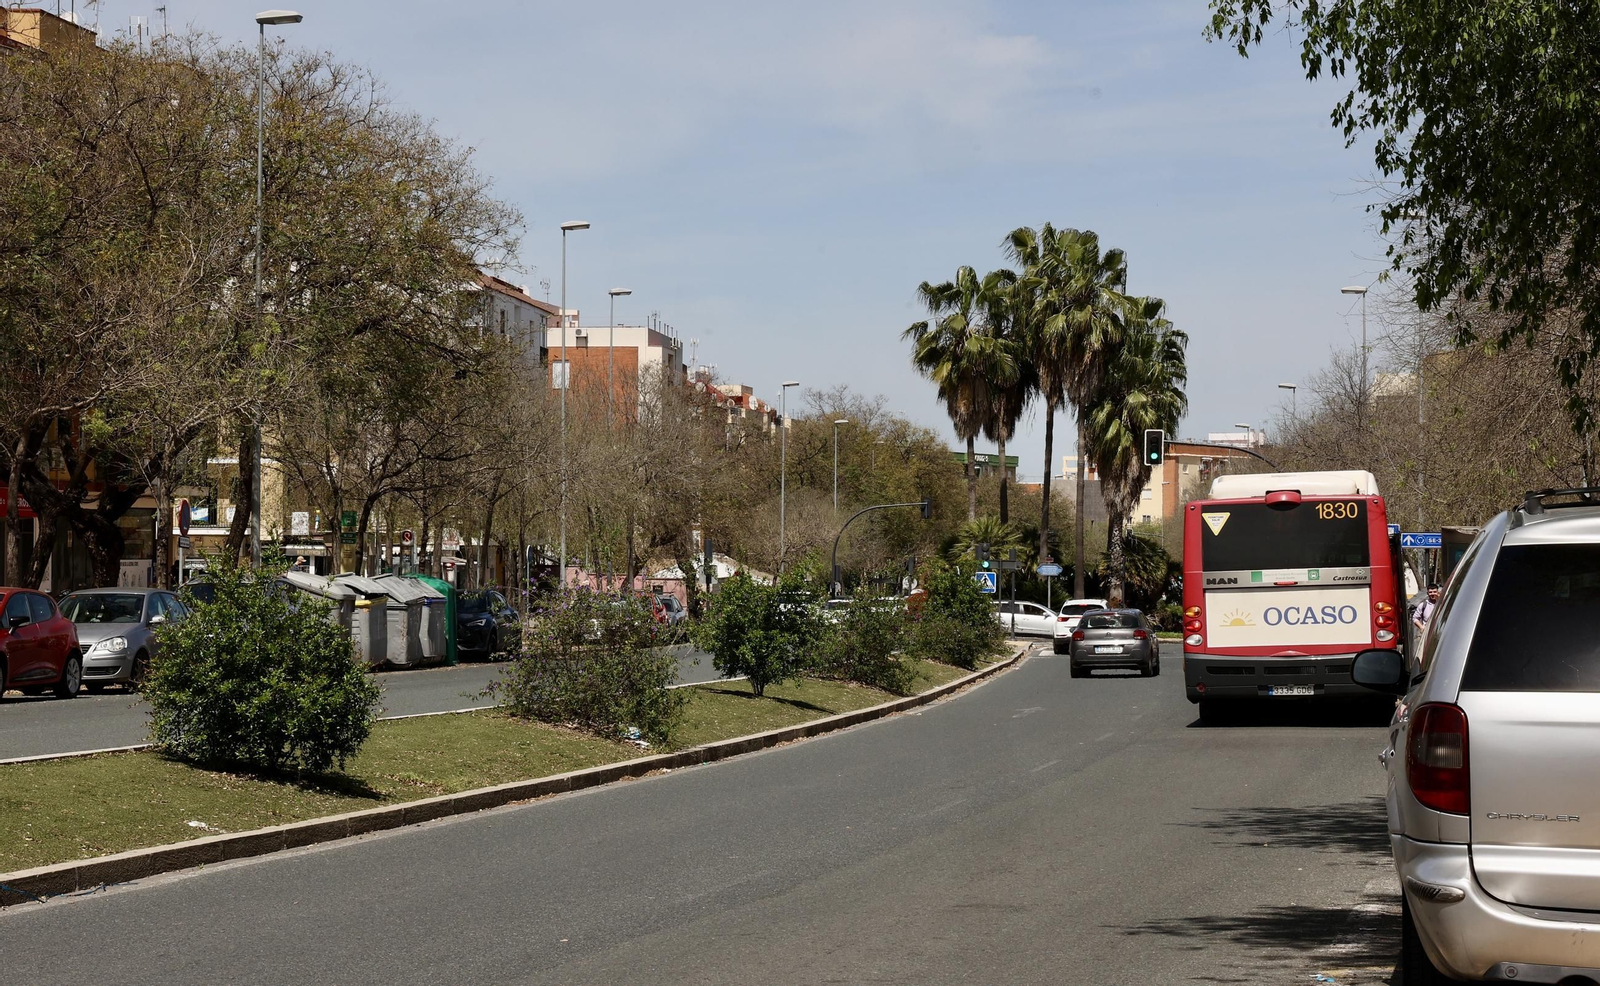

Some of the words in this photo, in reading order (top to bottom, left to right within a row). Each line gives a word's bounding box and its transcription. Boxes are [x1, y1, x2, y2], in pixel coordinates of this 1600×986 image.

[1315, 501, 1358, 521] 1830
[1206, 577, 1238, 585] MAN
[1263, 604, 1358, 626] OCASO
[1274, 686, 1294, 694] 3335
[1486, 811, 1580, 823] CHRYSLER
